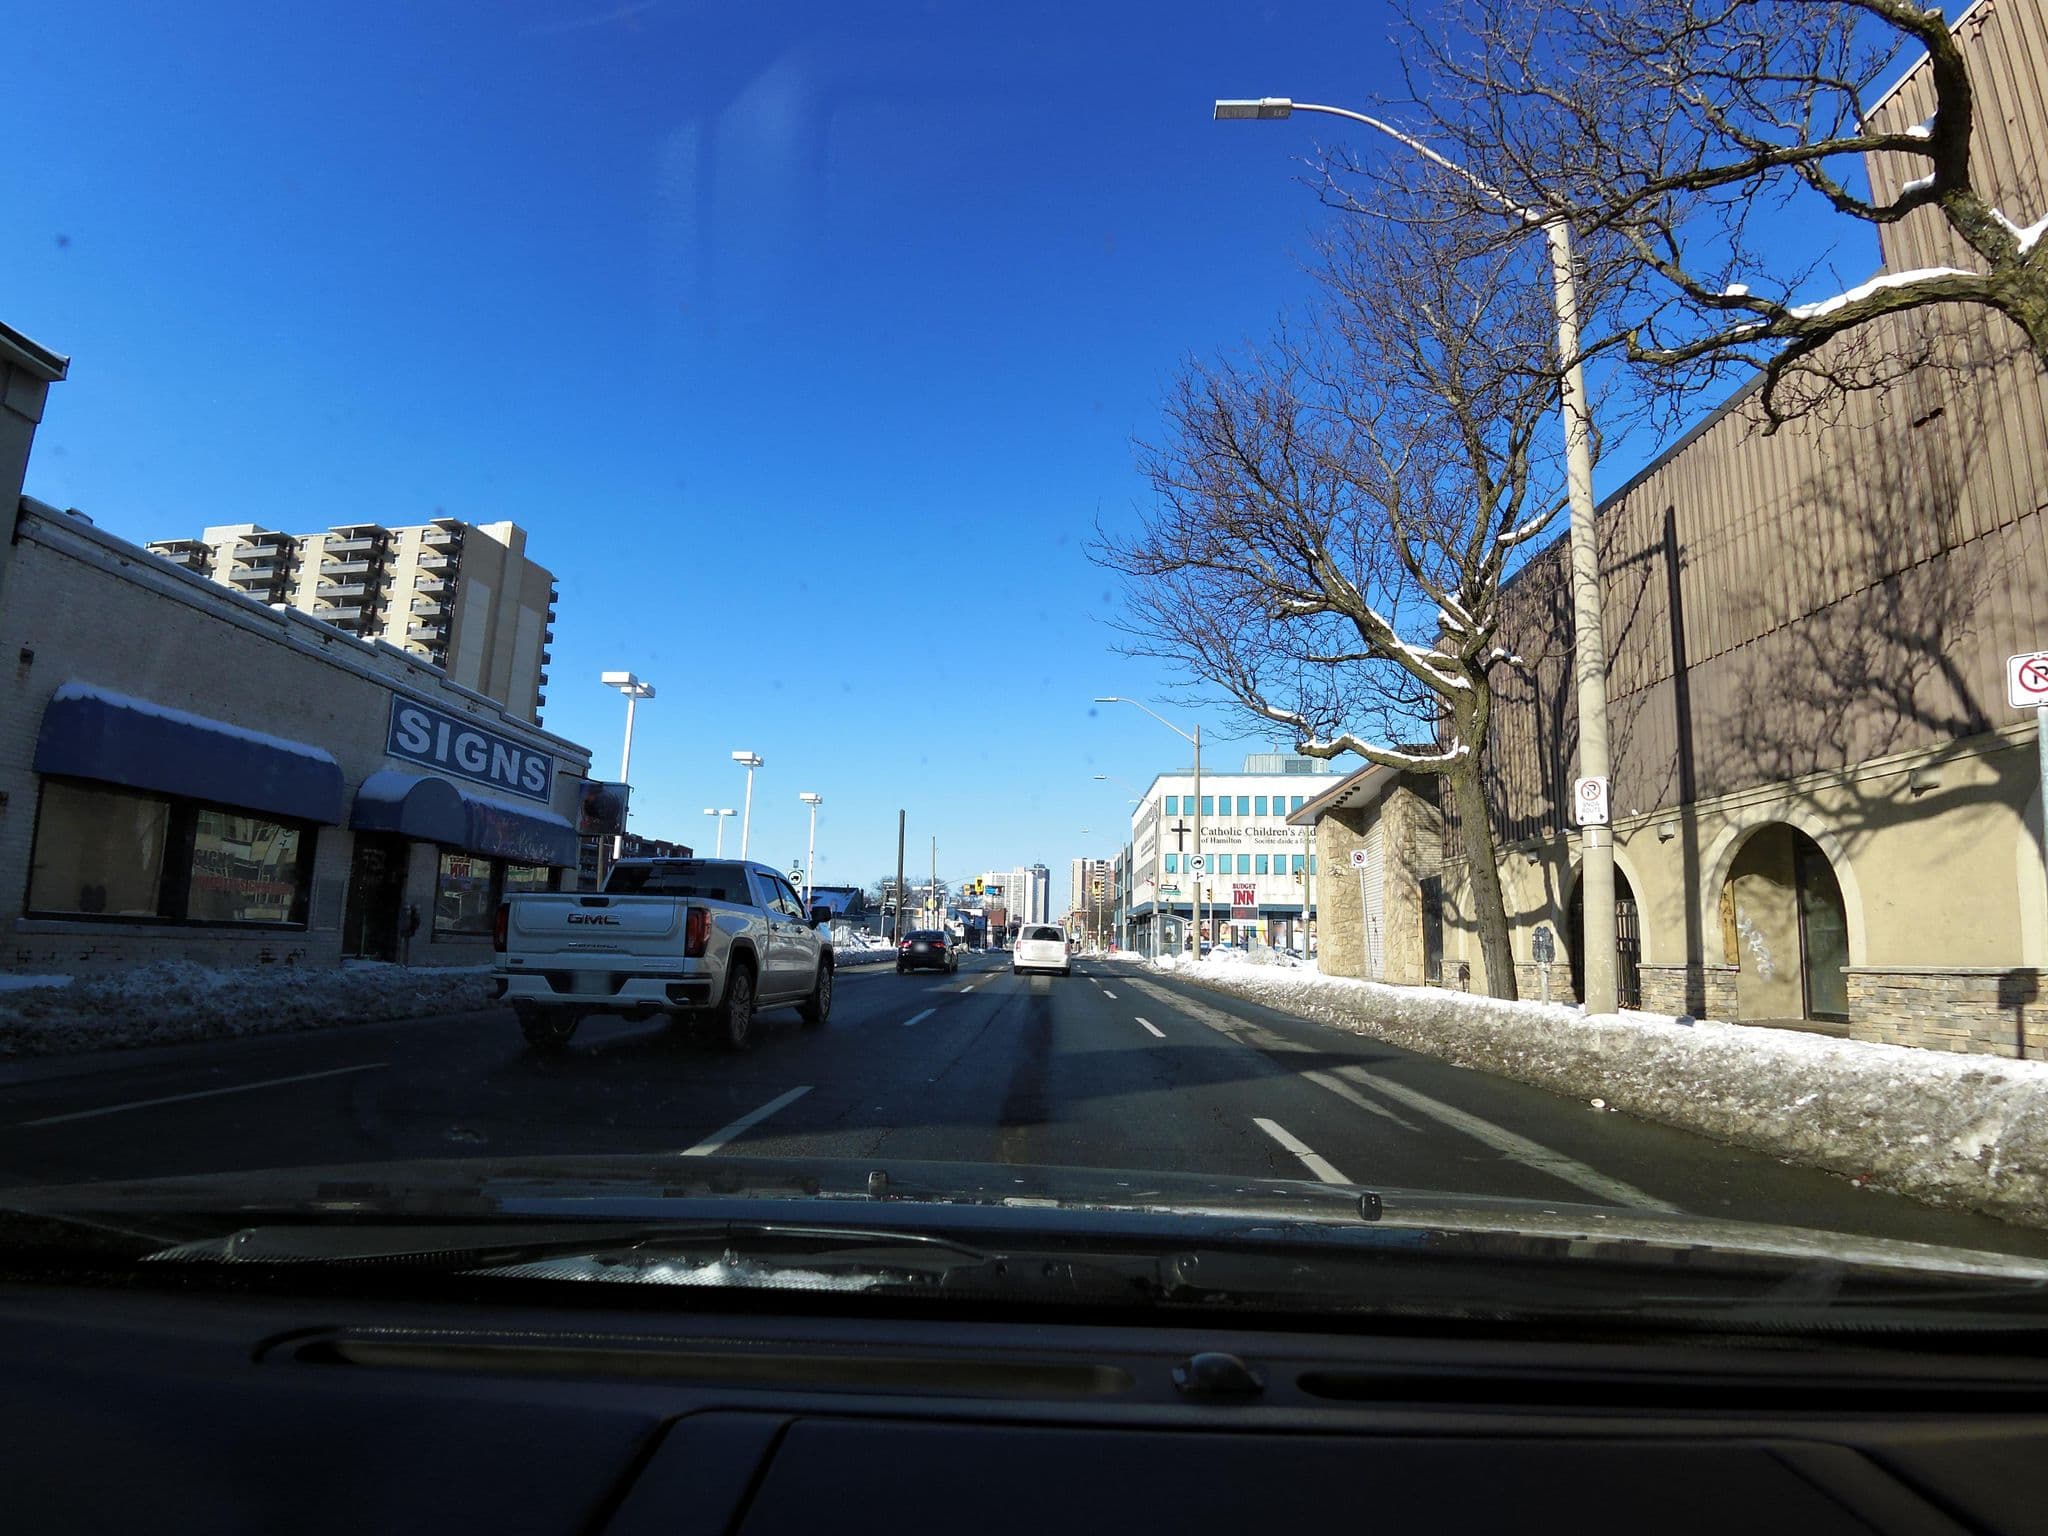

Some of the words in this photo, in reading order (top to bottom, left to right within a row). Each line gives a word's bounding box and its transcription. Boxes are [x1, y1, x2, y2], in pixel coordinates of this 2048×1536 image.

[396, 708, 546, 792] SIGNS
[1200, 826, 1242, 836] Catholic
[1244, 826, 1295, 837] Children's
[1297, 826, 1317, 837] Ad
[1200, 836, 1209, 844] of
[1210, 836, 1242, 845] Hamilton
[1232, 882, 1256, 890] BUDGET
[1233, 889, 1255, 906] INN
[567, 913, 621, 926] GMC
